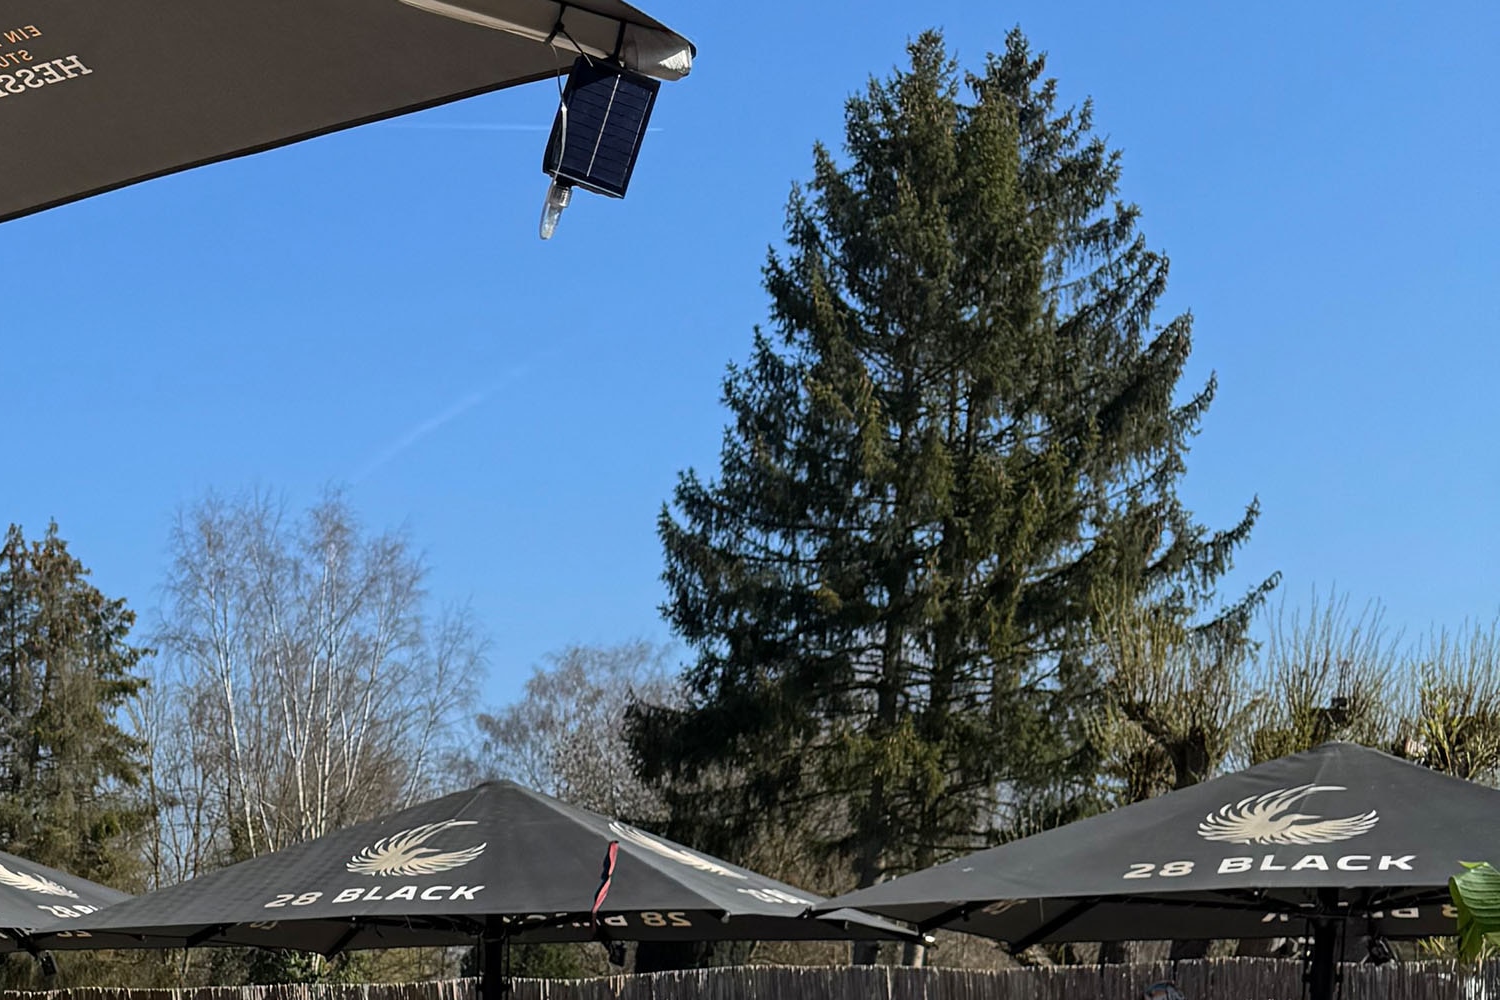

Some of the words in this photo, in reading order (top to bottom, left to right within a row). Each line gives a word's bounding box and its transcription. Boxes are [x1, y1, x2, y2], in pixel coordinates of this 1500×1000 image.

[1122, 861, 1195, 879] 28
[1217, 854, 1418, 874] BLACK
[264, 891, 323, 908] 28
[331, 885, 485, 903] BLACK
